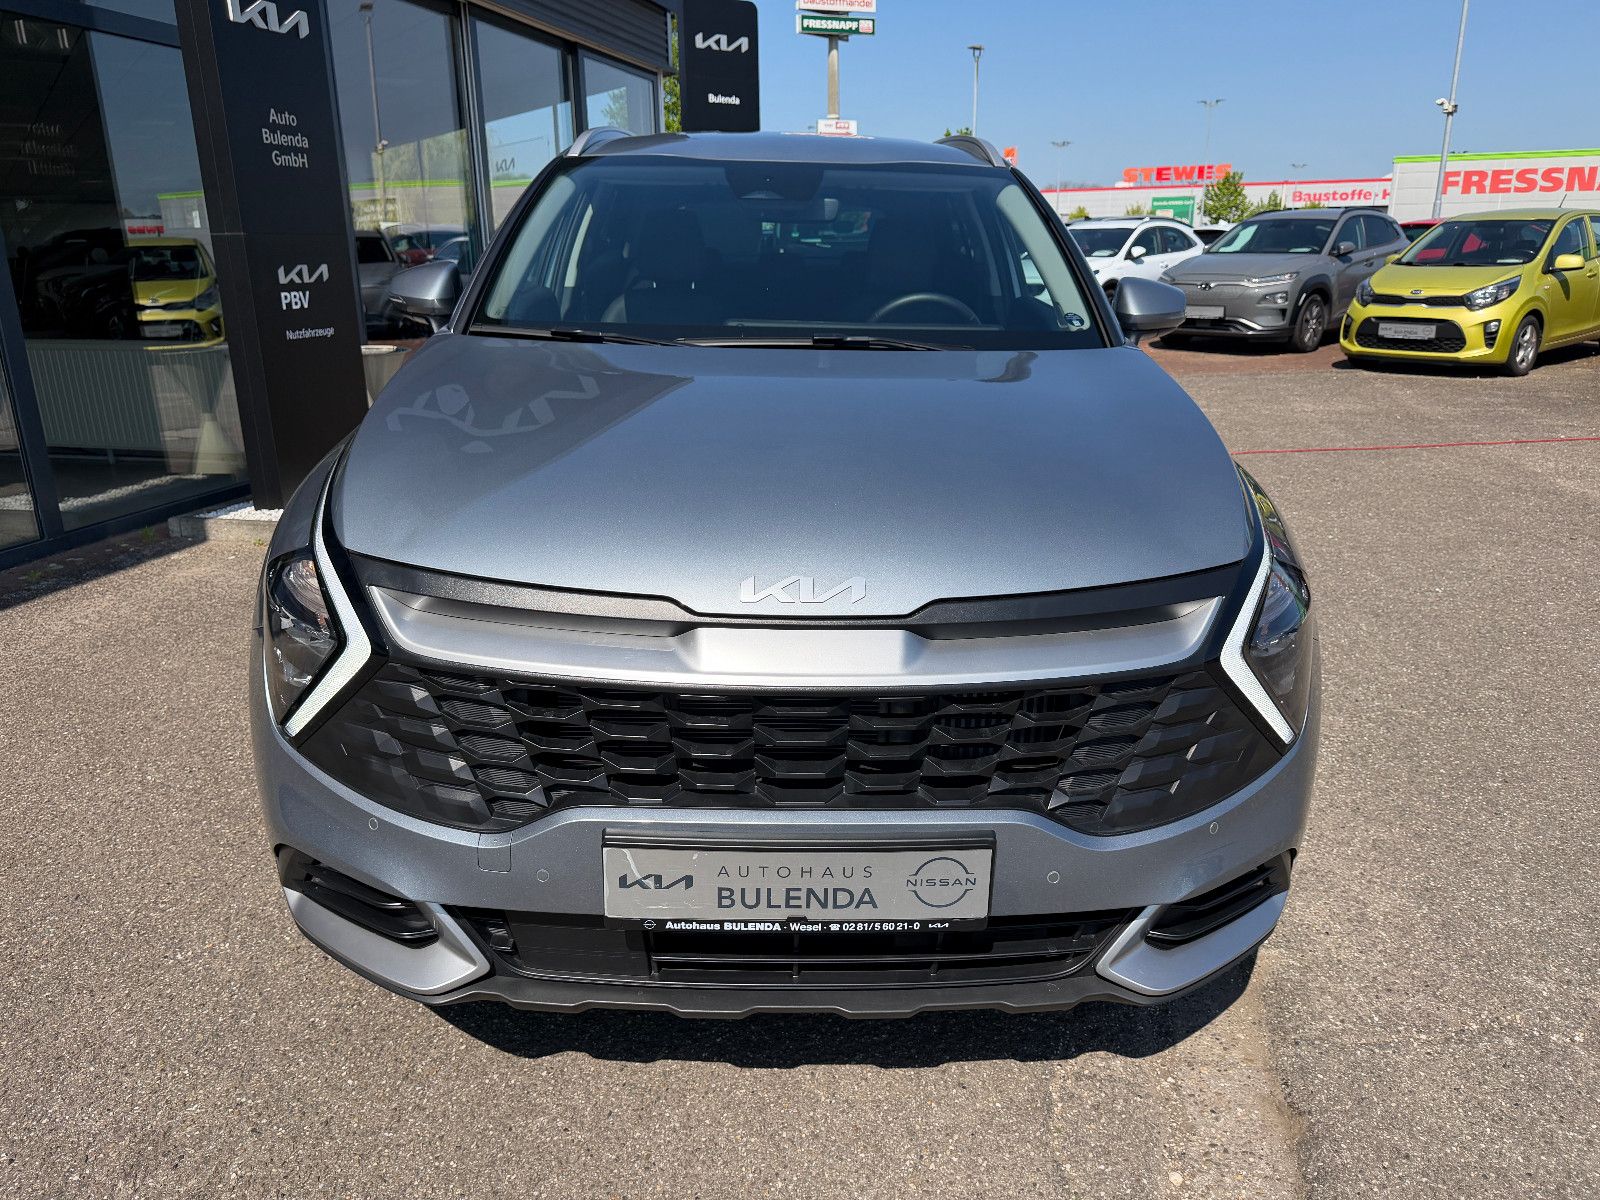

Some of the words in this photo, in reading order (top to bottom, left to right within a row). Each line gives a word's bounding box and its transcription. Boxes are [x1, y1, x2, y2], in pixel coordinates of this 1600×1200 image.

[803, 19, 858, 31] FRESSNAPF
[694, 32, 749, 53] KIA
[708, 93, 741, 105] Bulenda
[269, 108, 298, 127] Auto
[262, 128, 309, 149] Bulenda
[272, 150, 309, 169] GmbH
[1441, 166, 1600, 195] FRESSN
[1292, 188, 1373, 203] Baustoffe
[277, 264, 330, 285] KIA
[280, 290, 310, 310] PBV
[286, 326, 335, 340] Nutzfahrzeuge
[740, 575, 867, 604] KIA
[618, 873, 694, 890] KIA
[716, 865, 874, 879] AUTOHAUS
[906, 877, 977, 888] NISSAN
[716, 886, 879, 910] BULENDA
[665, 921, 721, 931] Autohaus
[723, 922, 782, 932] BULENDA
[789, 922, 822, 932] Wesel
